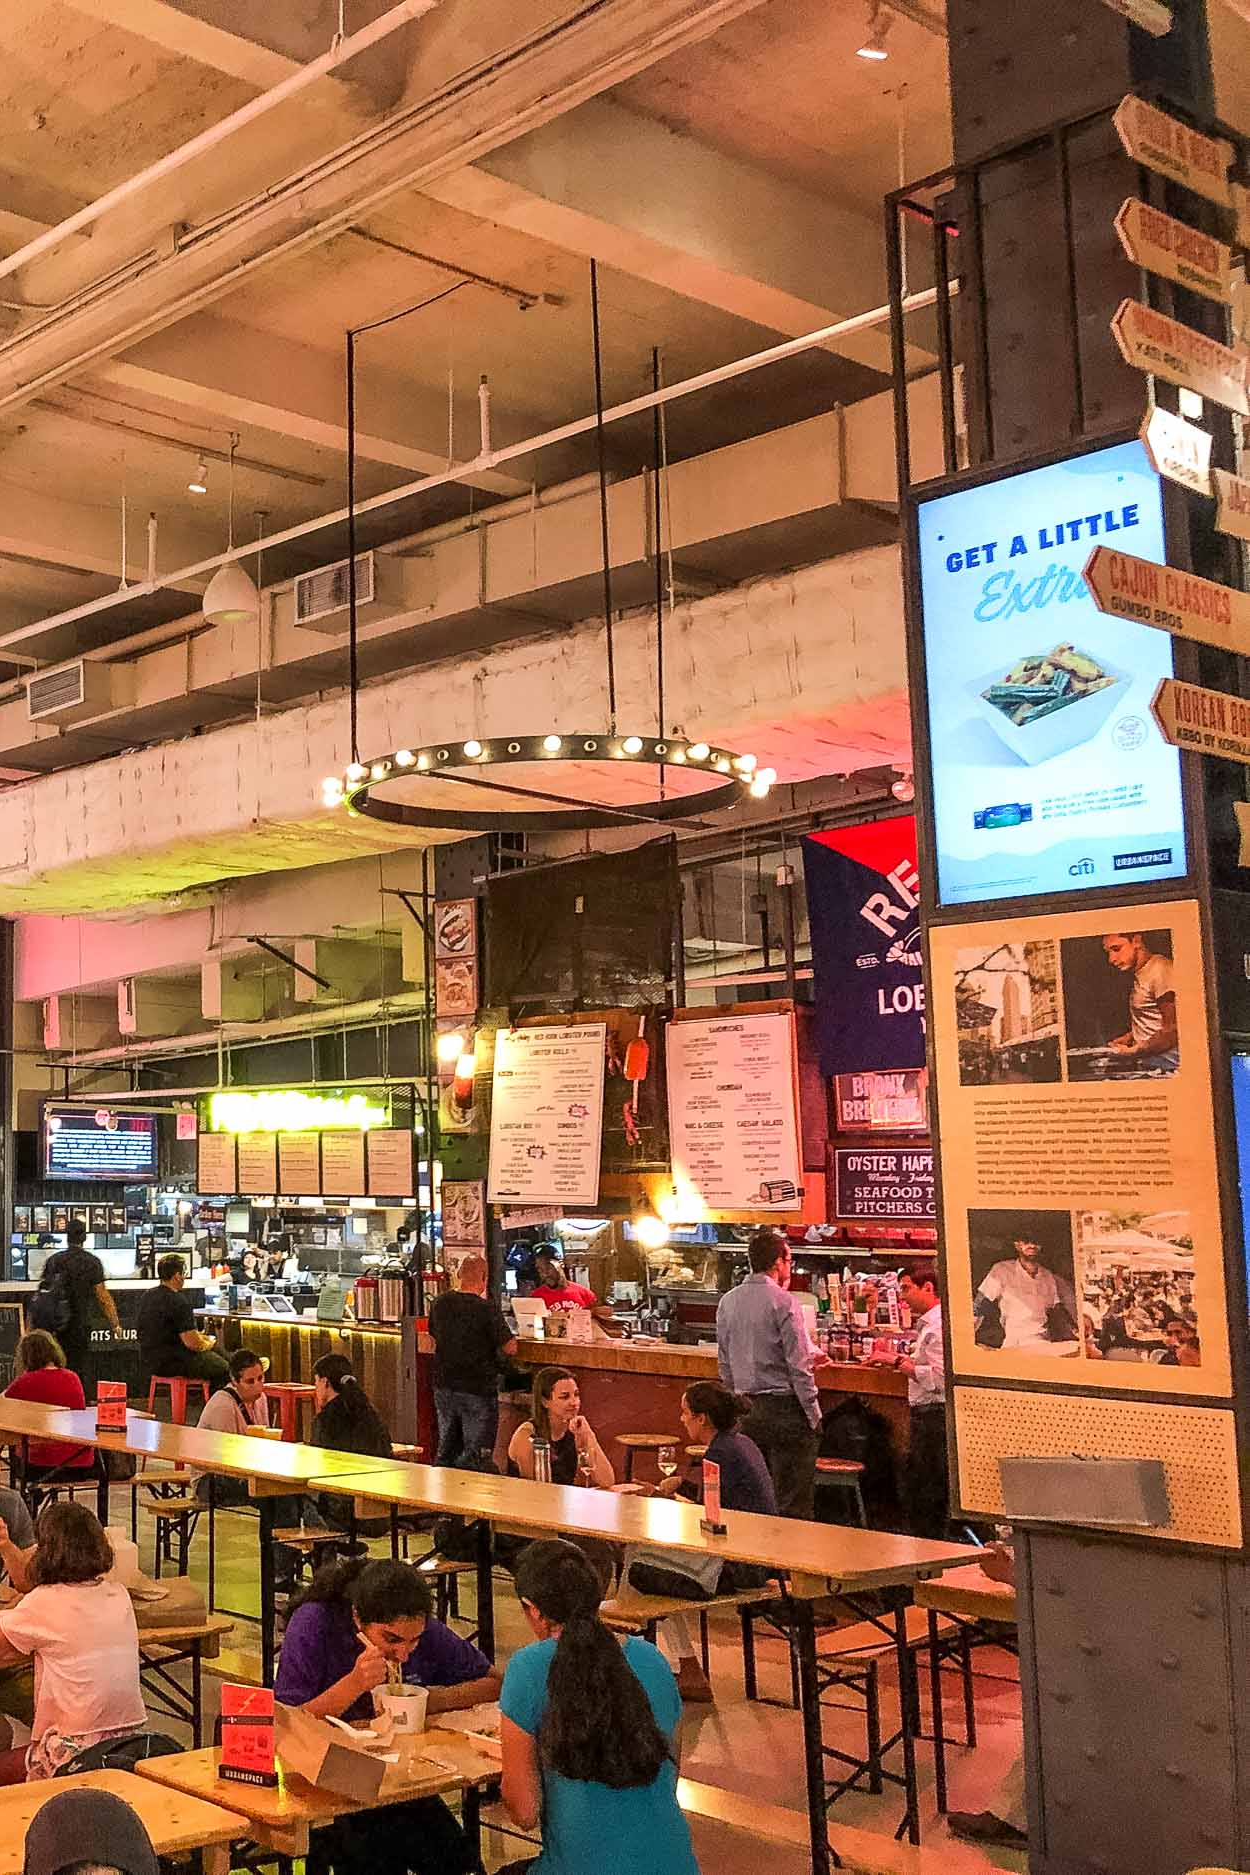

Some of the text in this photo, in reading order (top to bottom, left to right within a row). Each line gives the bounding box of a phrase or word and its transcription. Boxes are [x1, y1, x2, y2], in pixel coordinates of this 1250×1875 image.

[947, 504, 1140, 573] GET A LITTLE
[1110, 554, 1231, 625] CAJUN CLASSICS
[1111, 596, 1183, 630] GUMBO BROS
[1174, 686, 1226, 732] KOREAN
[1069, 858, 1095, 876] citi
[852, 1073, 906, 1098] BRONX
[847, 1155, 897, 1172] OYSTER
[854, 1186, 923, 1199] SEAFOOD
[855, 1201, 923, 1214] PITCHERS
[224, 1769, 264, 1785] URBANSPACE
